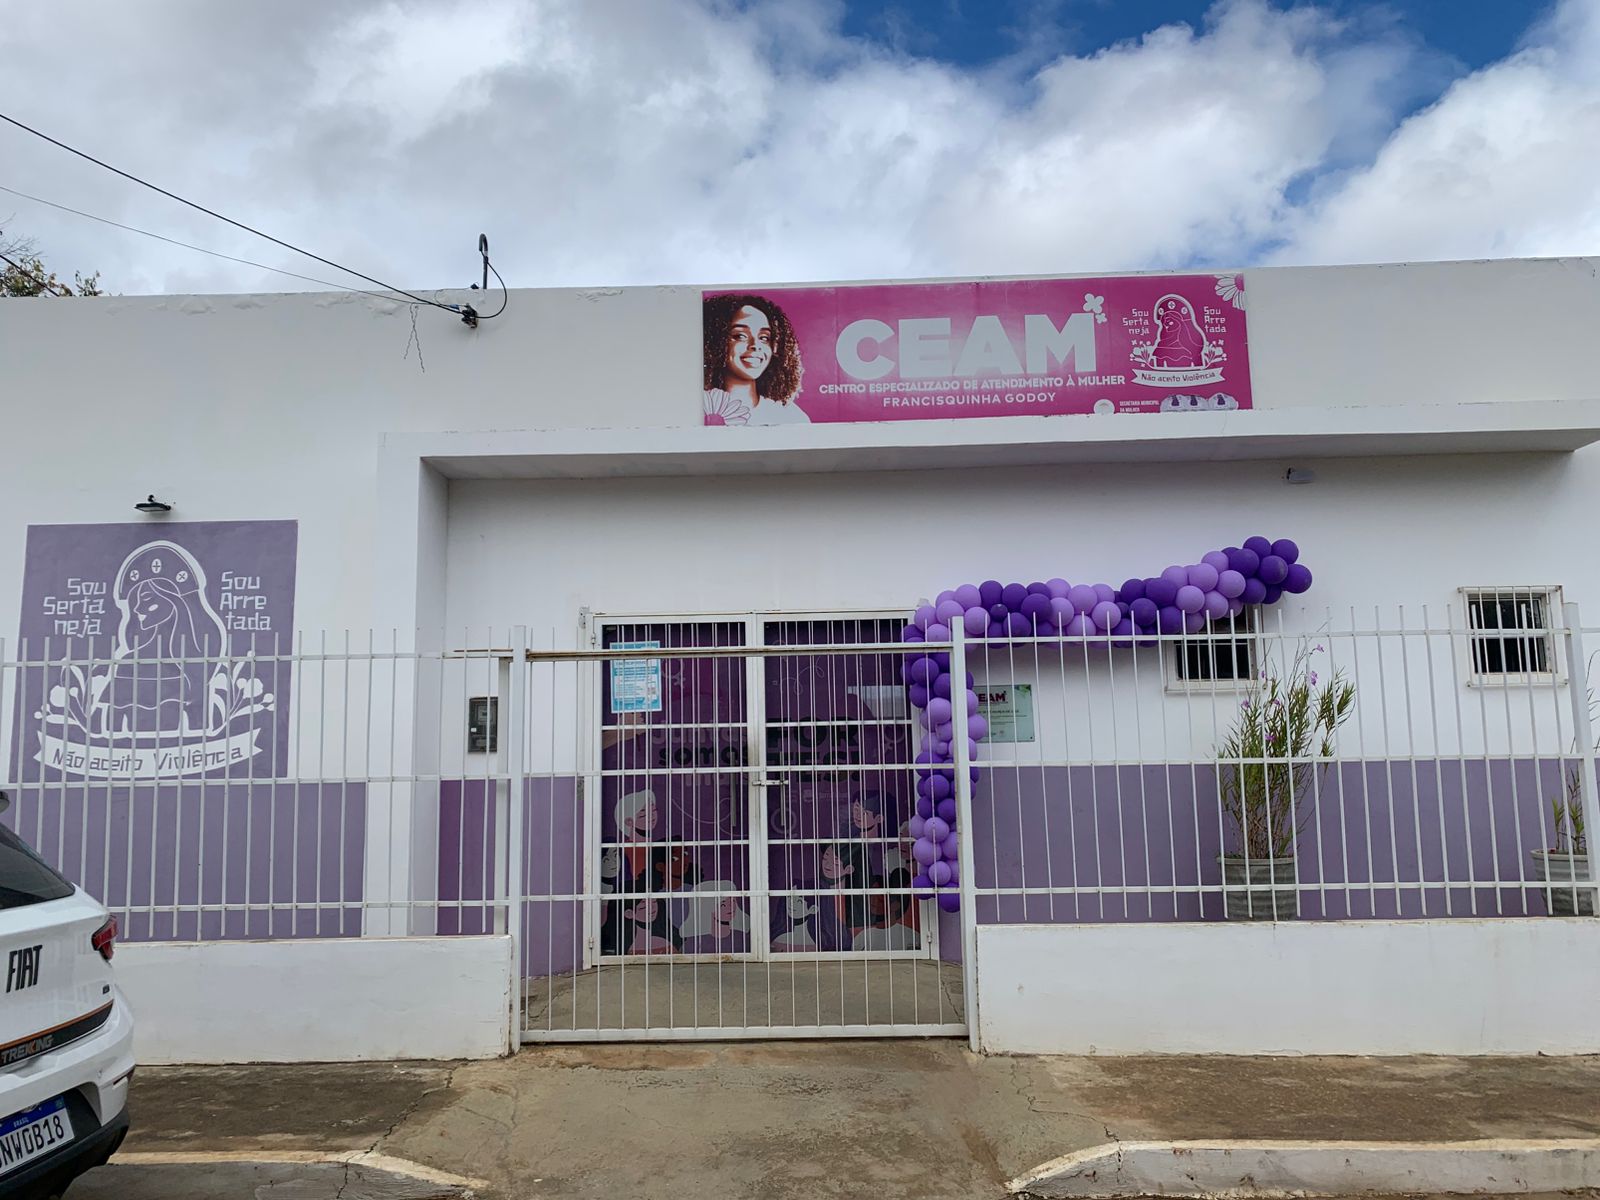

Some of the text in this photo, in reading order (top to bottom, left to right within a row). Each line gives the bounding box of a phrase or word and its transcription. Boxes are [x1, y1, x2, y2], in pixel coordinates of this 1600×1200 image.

[1132, 308, 1149, 317] Sou
[1204, 306, 1221, 315] Sou
[1204, 315, 1226, 324] Arre
[1122, 317, 1149, 326] Serta
[1204, 324, 1227, 333] tada
[1128, 327, 1150, 336] neja
[836, 313, 1096, 380] CEAM
[819, 374, 1126, 394] CENTRO ESPECIALIZADO DE ATENDIMENTO À MULHER
[1141, 372, 1216, 383] Não aceito Violência
[883, 392, 1057, 407] FRANCISQUINHA GODOY
[67, 578, 107, 596] Sou
[221, 571, 261, 590] Sou
[43, 596, 105, 615] Serta
[219, 592, 267, 611] Arre
[54, 615, 102, 638] neja
[225, 611, 272, 631] tada
[978, 693, 1006, 703] EAM
[52, 747, 243, 772] Não aceito Violênca
[6, 944, 43, 993] FIAT
[0, 1114, 64, 1168] NW0B18
